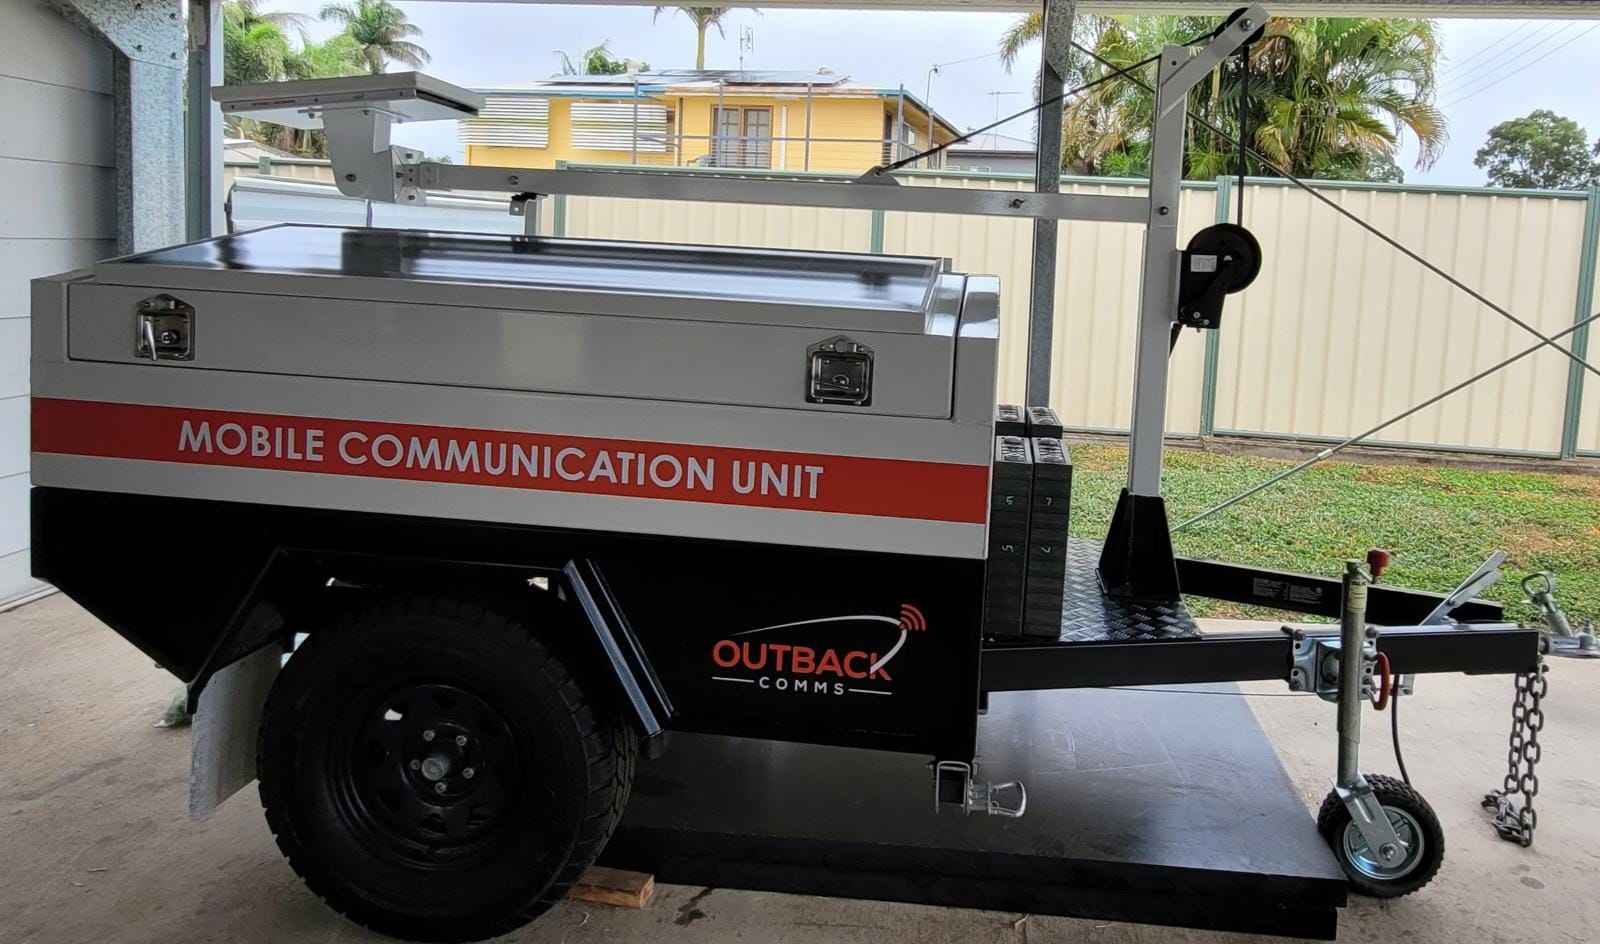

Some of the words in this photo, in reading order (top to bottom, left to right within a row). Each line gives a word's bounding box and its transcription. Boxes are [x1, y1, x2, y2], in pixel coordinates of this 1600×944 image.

[177, 419, 325, 462] MOBILE
[338, 431, 715, 491] COMMUNICATION
[731, 460, 824, 499] UNIT
[1005, 495, 1015, 506] 5
[1045, 496, 1053, 507] 7
[712, 639, 893, 681] OUTBACK
[758, 676, 844, 695] COMMS
